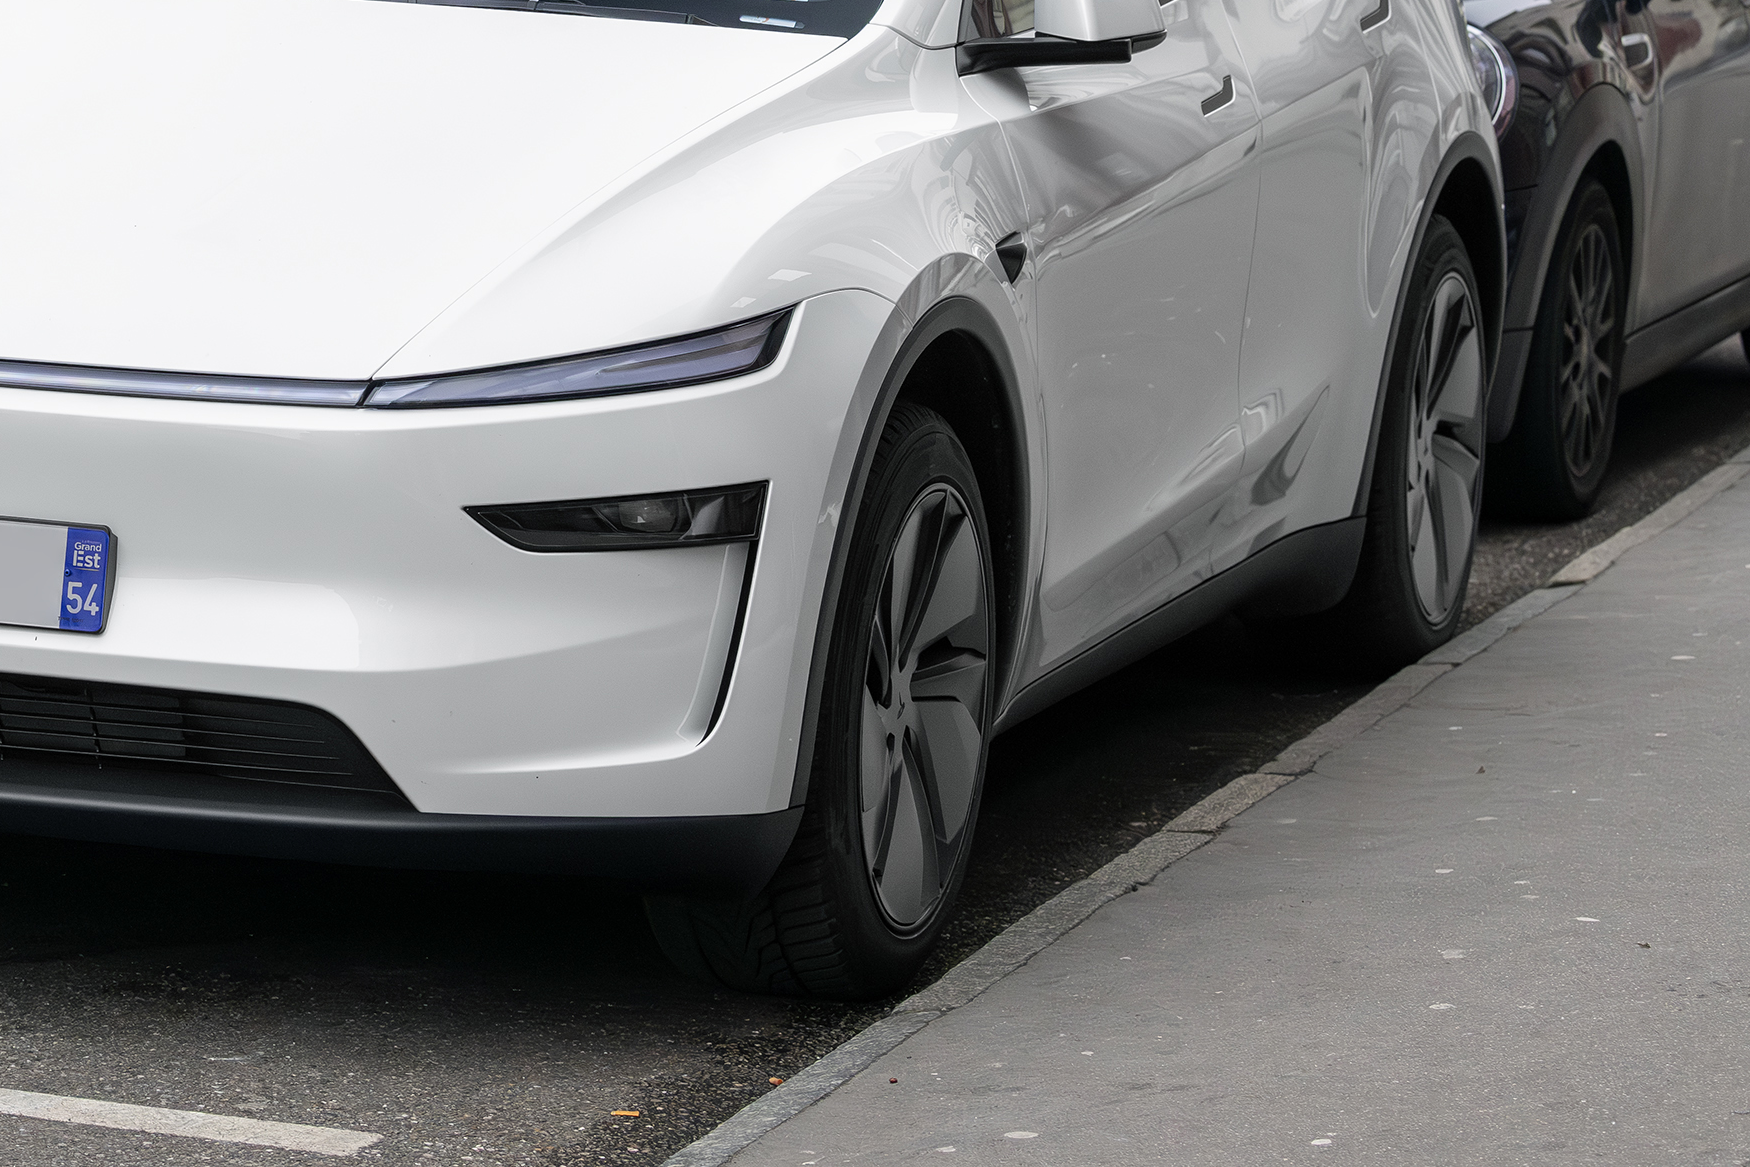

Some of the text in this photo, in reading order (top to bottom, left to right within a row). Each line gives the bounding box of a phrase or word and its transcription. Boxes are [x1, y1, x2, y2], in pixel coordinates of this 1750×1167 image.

[74, 541, 102, 552] Grand
[72, 550, 101, 568] Est
[66, 581, 100, 616] 54
